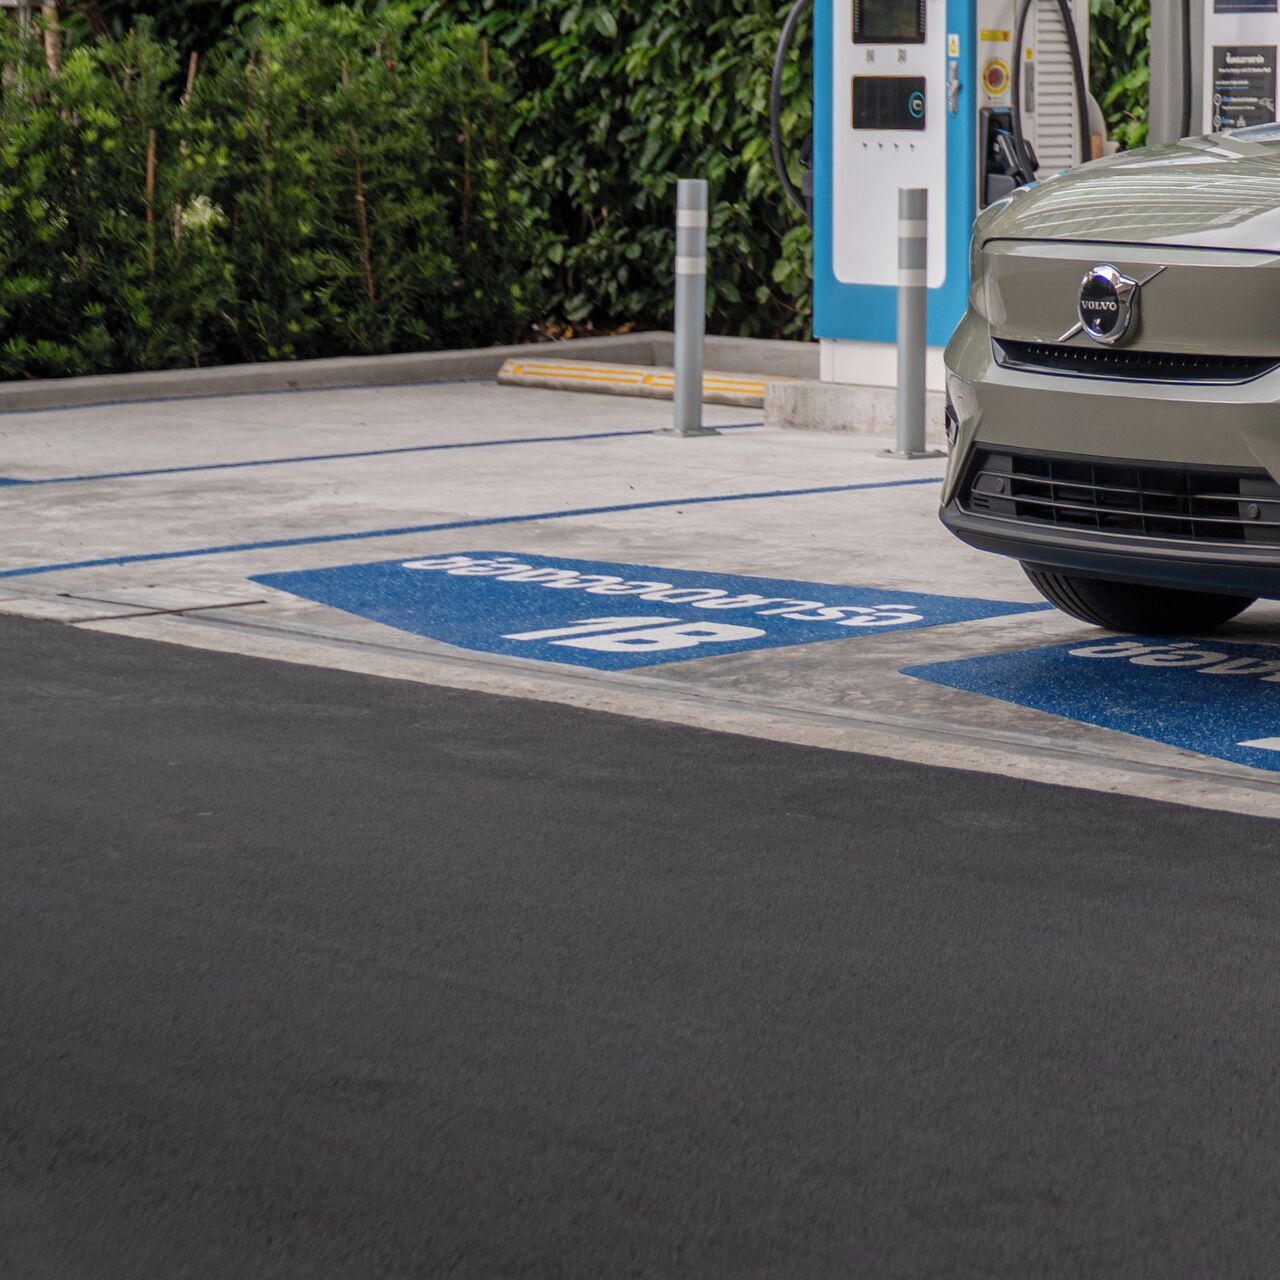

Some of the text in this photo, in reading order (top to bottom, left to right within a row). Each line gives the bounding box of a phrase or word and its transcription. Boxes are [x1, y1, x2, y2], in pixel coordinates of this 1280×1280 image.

[1080, 300, 1117, 312] VOLVO
[401, 556, 924, 627] ช่องจอดชาร์จ
[501, 617, 767, 652] 1B
